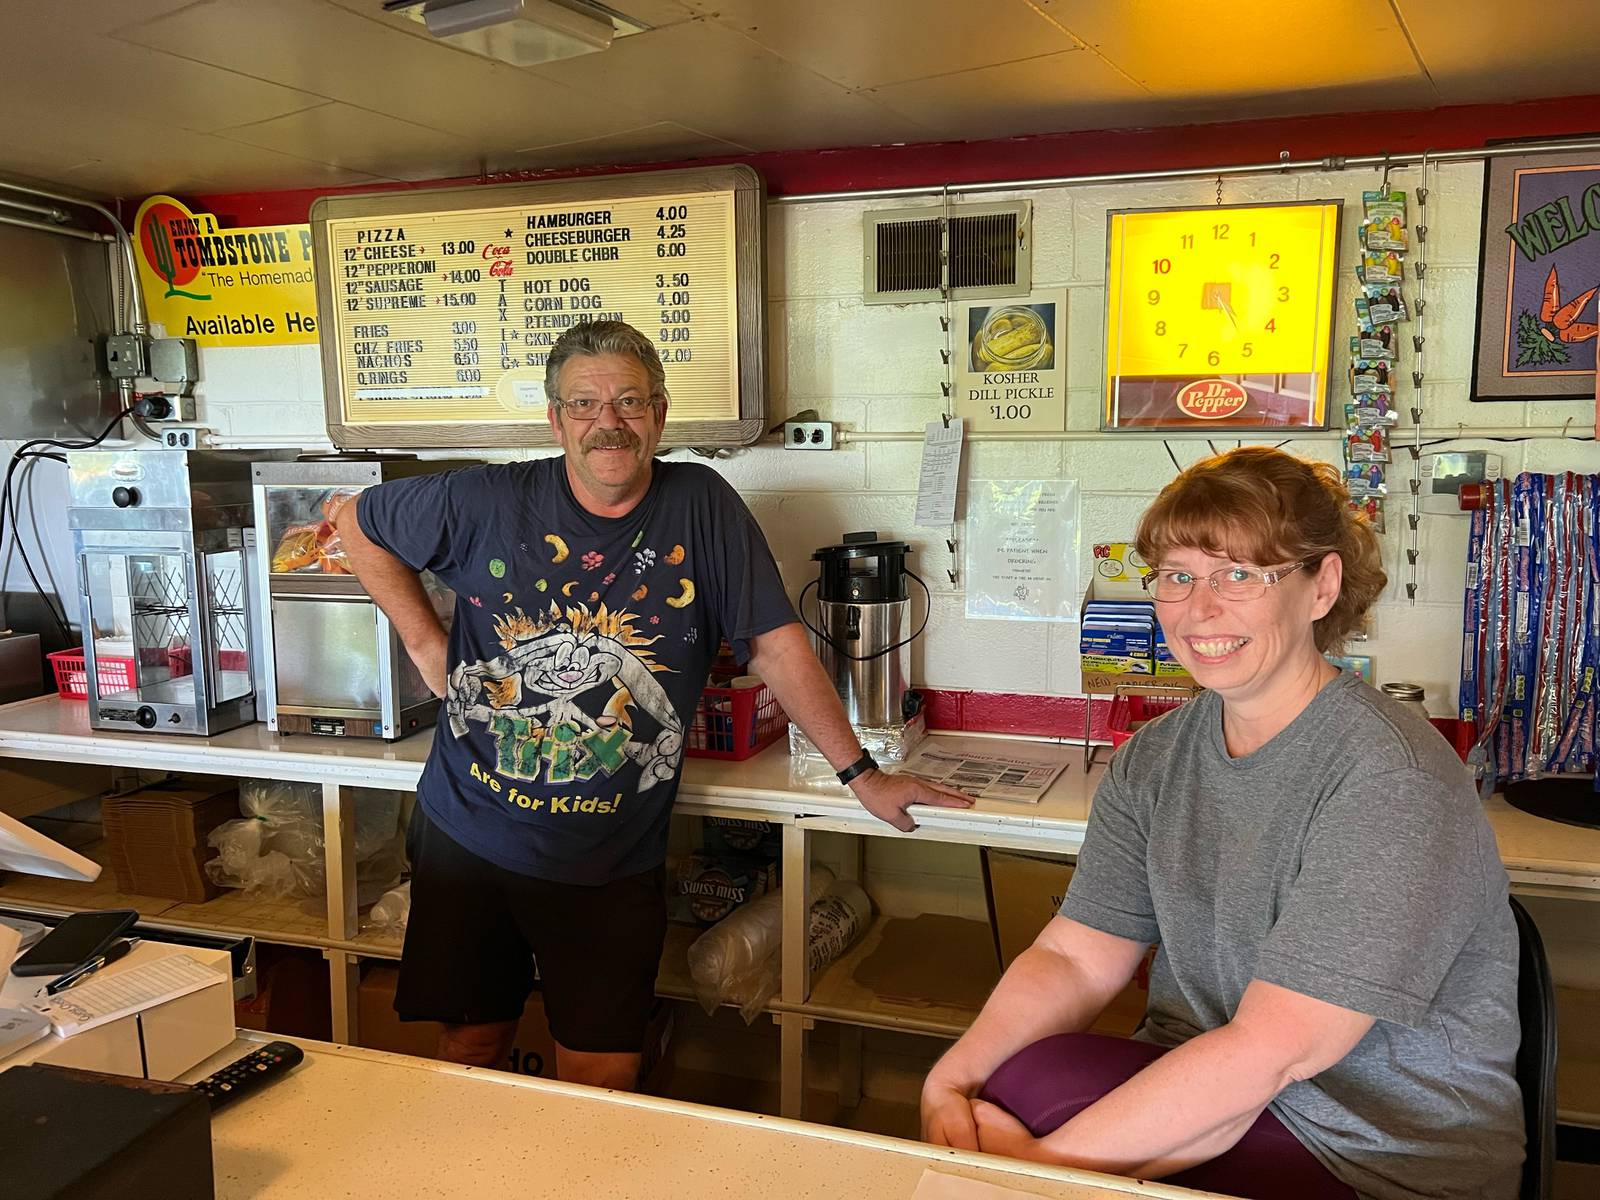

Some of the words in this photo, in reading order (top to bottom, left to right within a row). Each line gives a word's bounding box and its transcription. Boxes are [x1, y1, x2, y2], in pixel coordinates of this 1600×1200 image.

[527, 211, 612, 229] HAMBURGER
[656, 205, 687, 220] 4.00
[169, 218, 200, 236] ENJOY
[205, 217, 214, 234] A
[1212, 224, 1230, 240] 12
[357, 228, 405, 243] PIZZA
[525, 228, 631, 247] CHEESEBURGER
[657, 224, 686, 239] 4.25
[1180, 234, 1194, 249] 11
[1249, 232, 1256, 247] 1
[174, 232, 290, 268] TOMBSTONE
[364, 244, 416, 260] CHEESE
[441, 240, 475, 255] 13.00
[482, 244, 511, 260] Coca
[527, 249, 578, 265] DOUBLE
[582, 246, 619, 262] CHBR
[657, 242, 686, 257] 6.00
[367, 260, 436, 276] PEPPERONI
[1152, 258, 1171, 274] 10
[1269, 253, 1280, 270] 2
[241, 268, 314, 286] Homemad
[450, 269, 481, 284] 14.00
[524, 280, 552, 294] HOT
[560, 278, 590, 292] DOG
[656, 273, 690, 288] 3.50
[365, 278, 424, 293] SAUSAGE
[366, 295, 427, 310] SUPREME
[443, 292, 476, 307] 15.00
[524, 297, 563, 311] CORN
[570, 295, 602, 309] DOG
[657, 291, 690, 306] 4.00
[1148, 290, 1160, 306] 9
[1277, 286, 1290, 302] 3
[661, 309, 691, 324] 5.00
[186, 314, 275, 336] Available
[354, 325, 389, 338] FRIES
[452, 321, 477, 334] 3.00
[1155, 321, 1166, 337] 8
[1264, 318, 1276, 334] 4
[354, 342, 379, 355] CHZ
[387, 340, 423, 354] FRIES
[454, 338, 478, 351] 5.50
[1178, 343, 1188, 359] 7
[1242, 342, 1253, 358] 5
[357, 354, 412, 368] NACHOS
[454, 352, 479, 365] 6.50
[659, 348, 692, 363] 2.00
[1207, 351, 1220, 367] 6
[983, 373, 1040, 385] KOSHER
[968, 389, 1001, 401] DILL
[1005, 387, 1055, 399] PICKLE
[1207, 384, 1231, 397] Dr
[1186, 391, 1243, 413] Pepper
[990, 405, 1032, 420] $1.00
[469, 761, 503, 793] Are
[507, 787, 545, 812] for
[550, 793, 623, 814] Kids!
